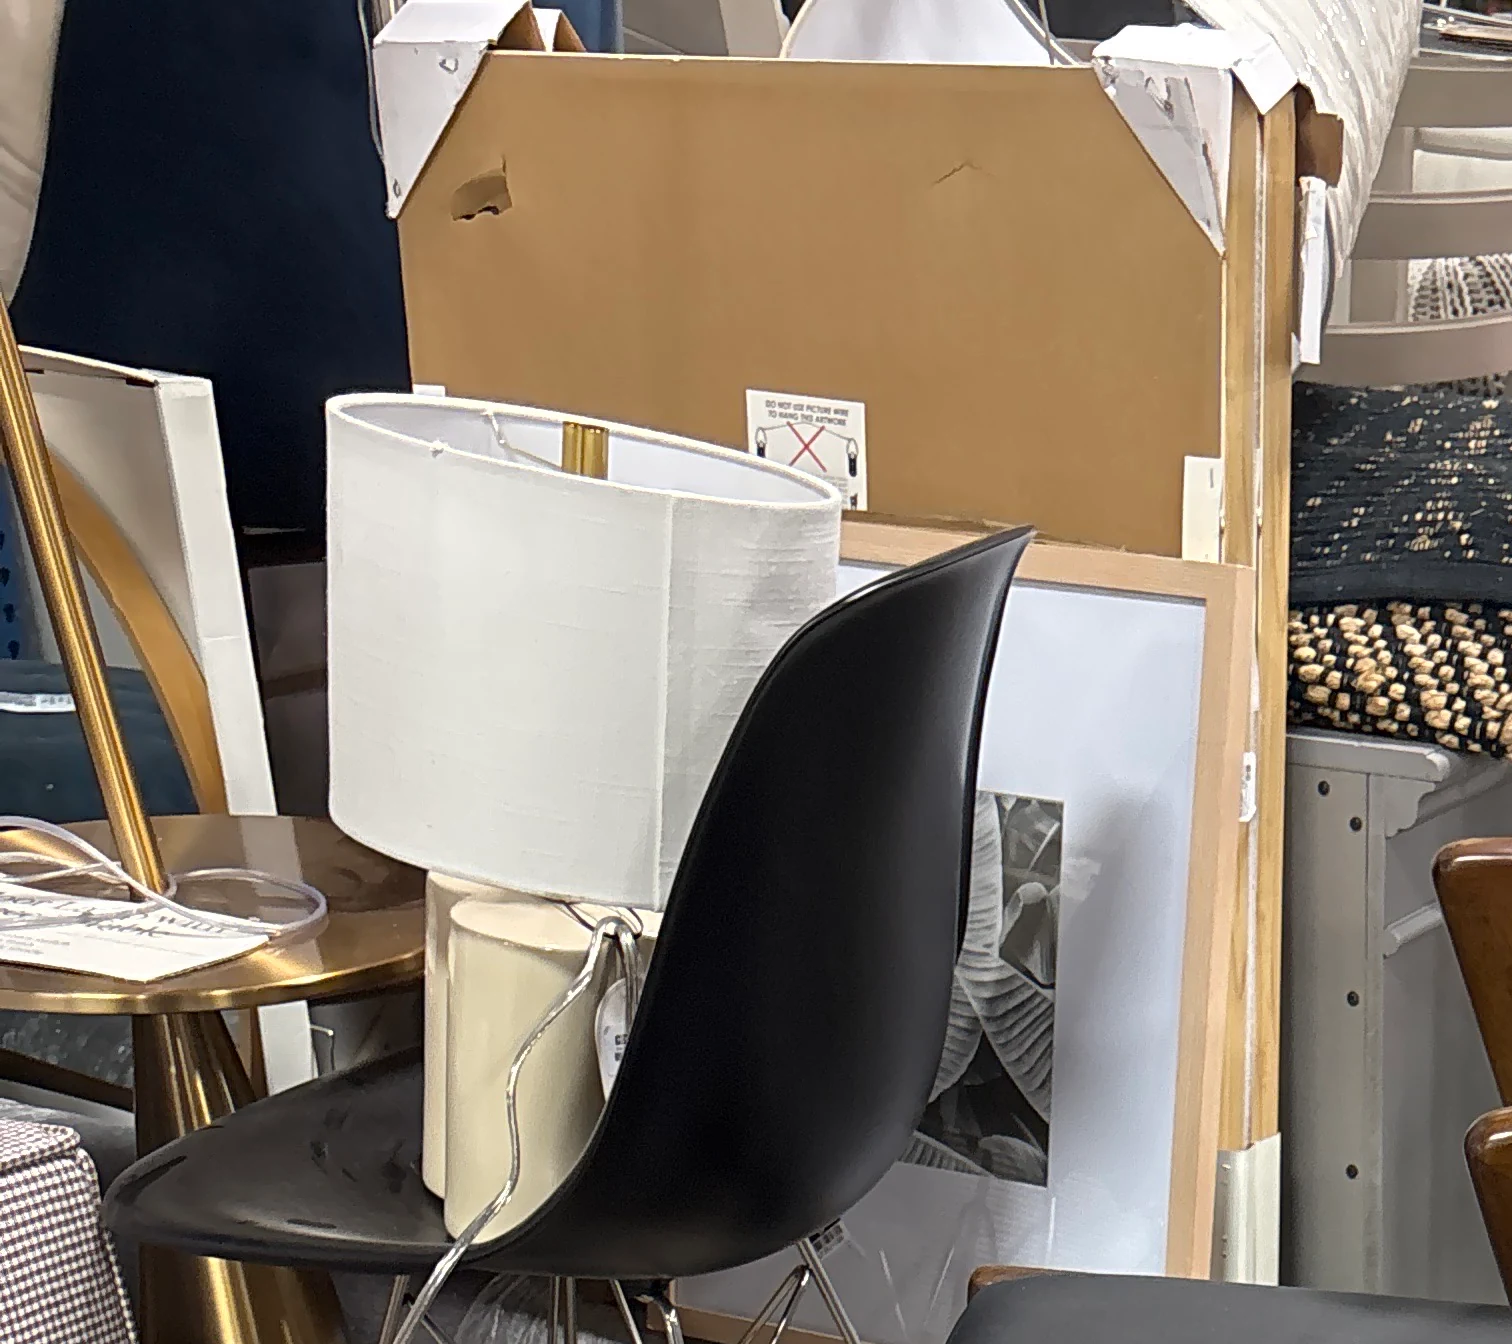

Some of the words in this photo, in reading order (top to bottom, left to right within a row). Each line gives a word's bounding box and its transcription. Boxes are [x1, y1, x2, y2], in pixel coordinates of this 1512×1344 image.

[765, 400, 776, 408] DO
[778, 402, 792, 410] NOT
[793, 403, 805, 411] USE
[806, 404, 831, 414] PICTURE
[833, 409, 849, 417] WIRE
[768, 410, 777, 418] TO
[779, 412, 798, 420] HANG
[815, 415, 846, 426] ARTWORK
